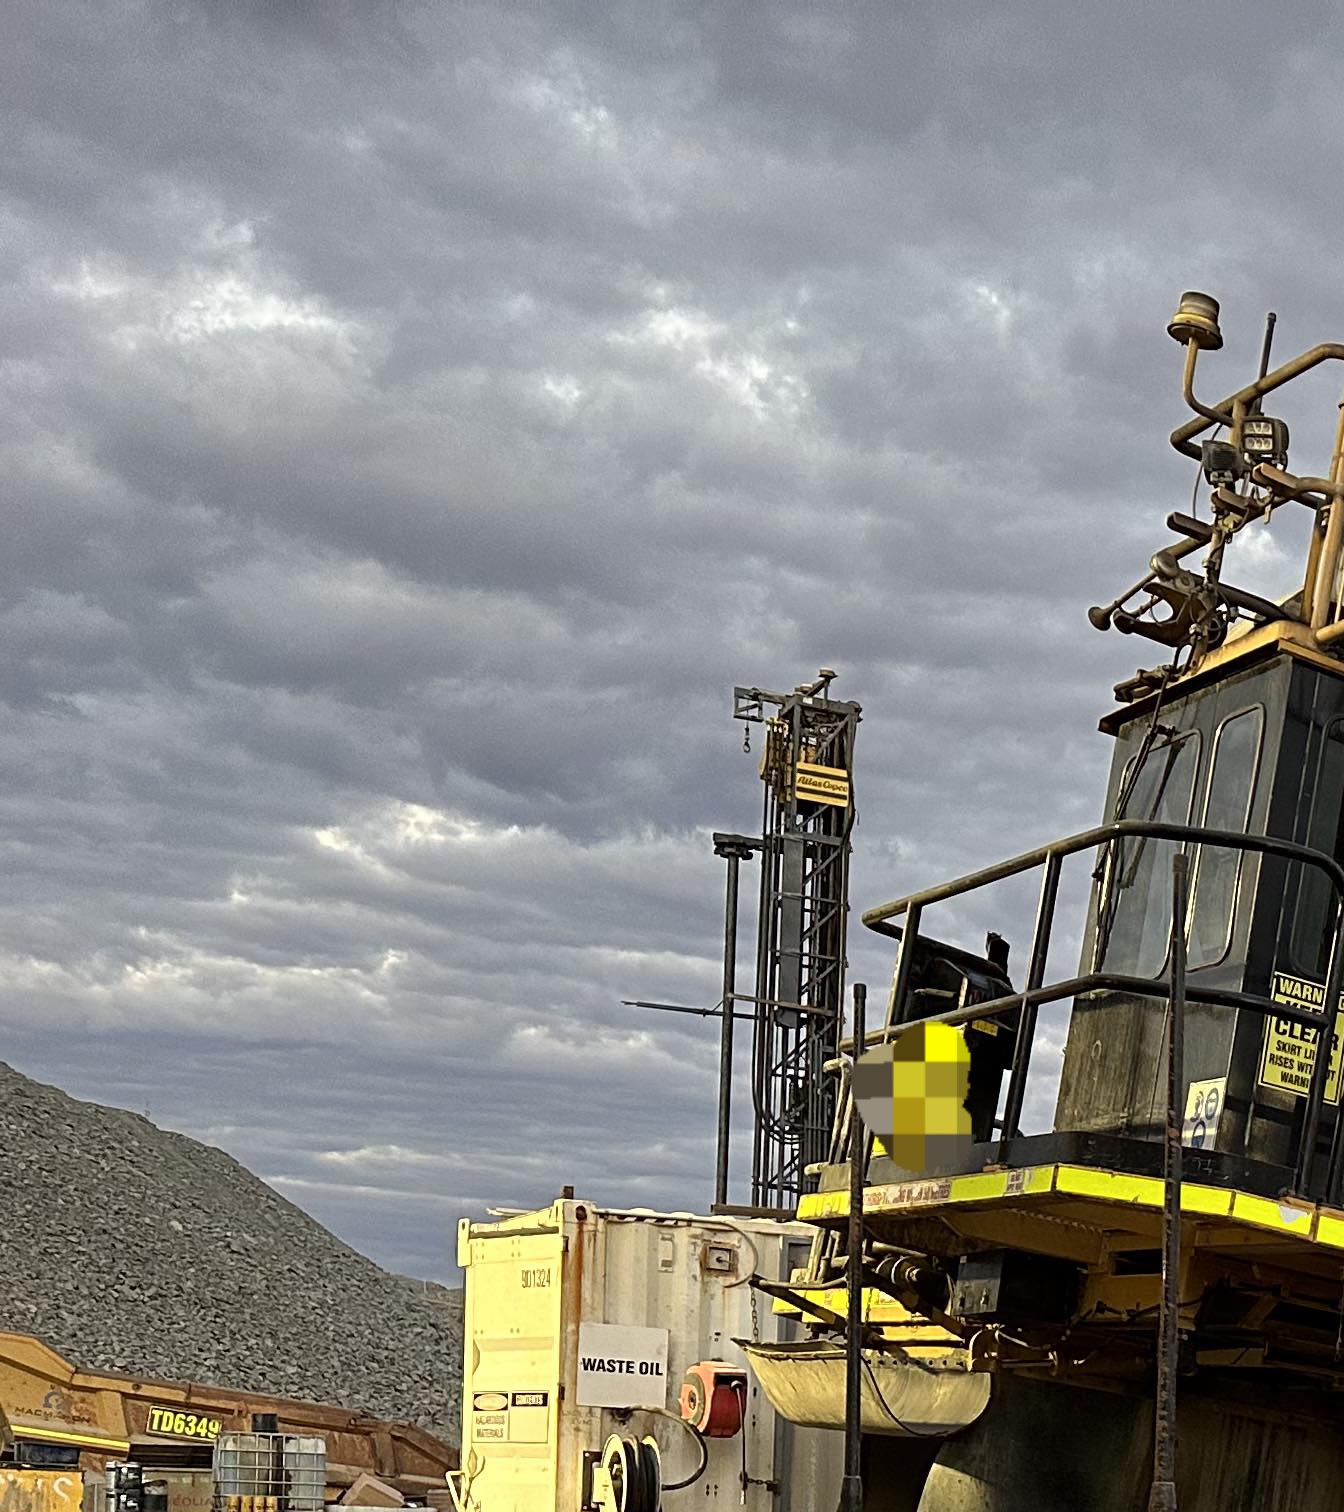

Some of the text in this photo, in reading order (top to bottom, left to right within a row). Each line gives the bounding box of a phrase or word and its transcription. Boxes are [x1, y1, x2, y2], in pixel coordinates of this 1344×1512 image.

[1276, 1040, 1302, 1056] SKIRT
[1268, 1053, 1295, 1070] RISES
[581, 1357, 663, 1376] WASTE OIL
[151, 1409, 220, 1439] TD6349
